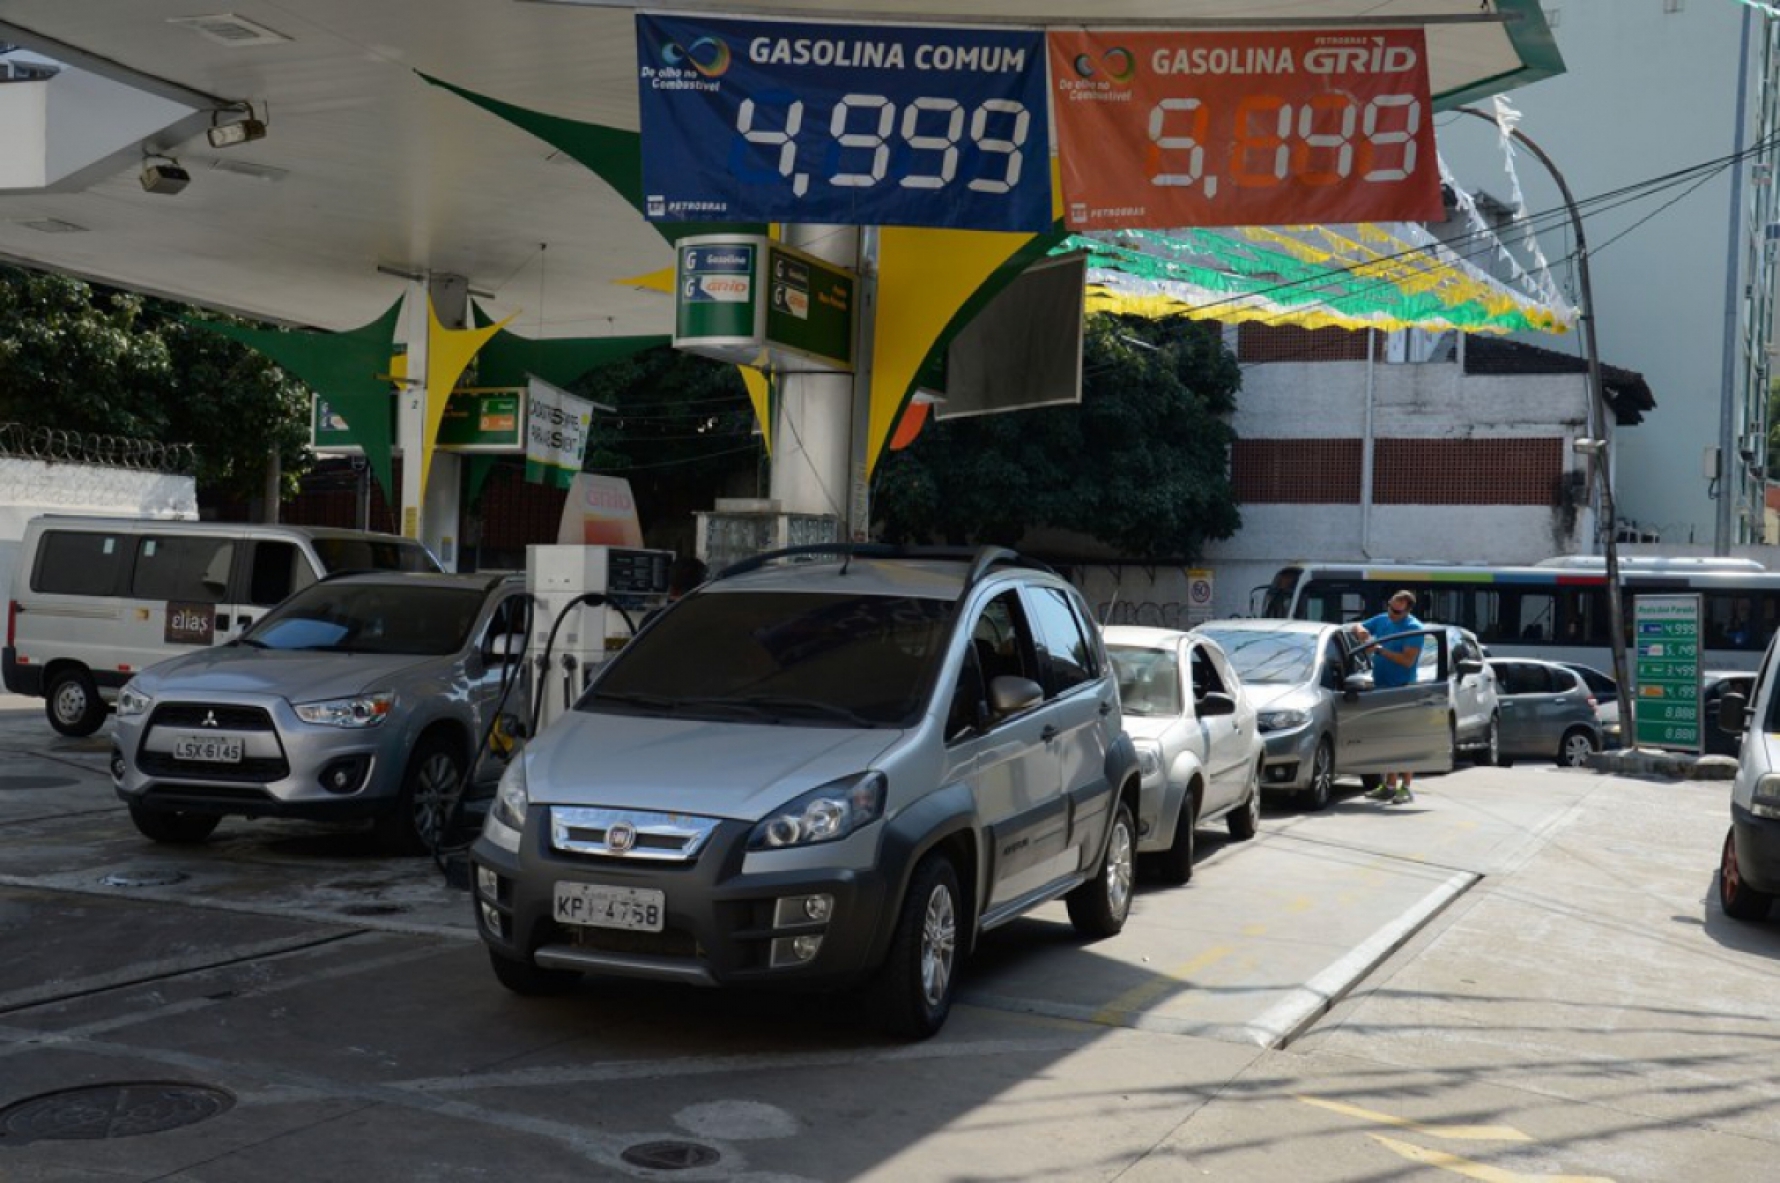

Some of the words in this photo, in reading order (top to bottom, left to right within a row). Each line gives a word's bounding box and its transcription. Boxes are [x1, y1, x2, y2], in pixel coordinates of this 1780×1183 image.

[749, 37, 904, 69] GASOLINA
[914, 45, 1026, 73] COMUM
[1152, 48, 1294, 75] GASOLINA
[641, 66, 655, 78] De
[659, 66, 682, 78] olho
[737, 93, 1031, 198] 4,999
[1148, 94, 1421, 199] 5,149
[668, 201, 727, 212] PETROBRAS
